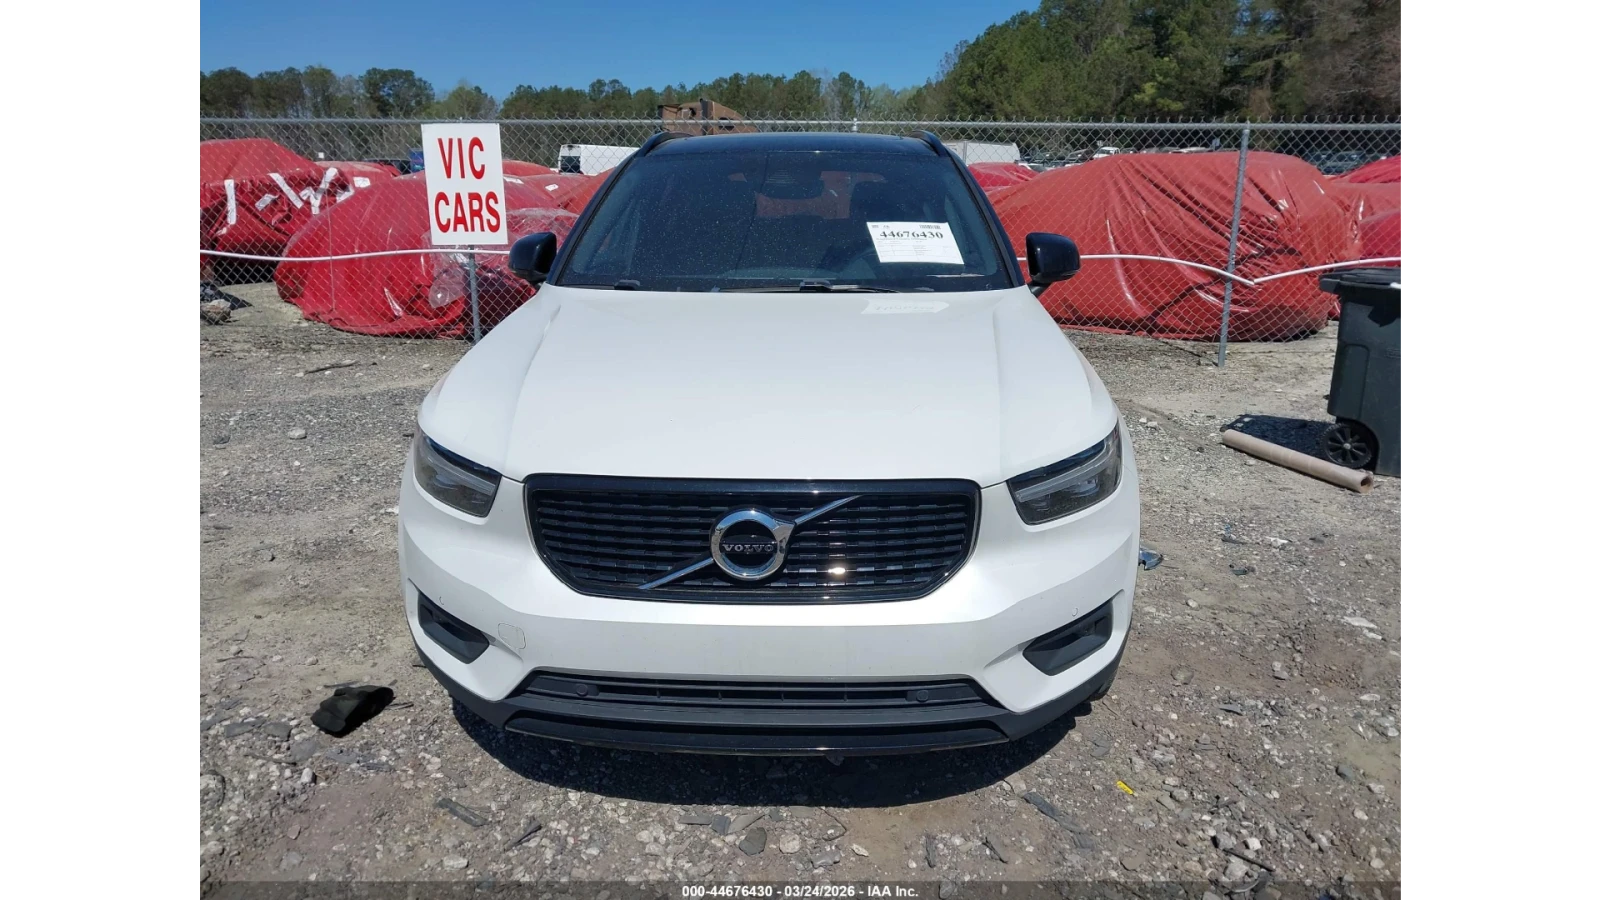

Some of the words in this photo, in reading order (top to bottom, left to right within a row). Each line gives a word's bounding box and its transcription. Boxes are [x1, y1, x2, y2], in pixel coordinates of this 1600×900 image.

[437, 136, 485, 180] VIC
[434, 191, 500, 233] CARS
[880, 230, 943, 239] 44676430
[722, 544, 774, 552] VOLVO
